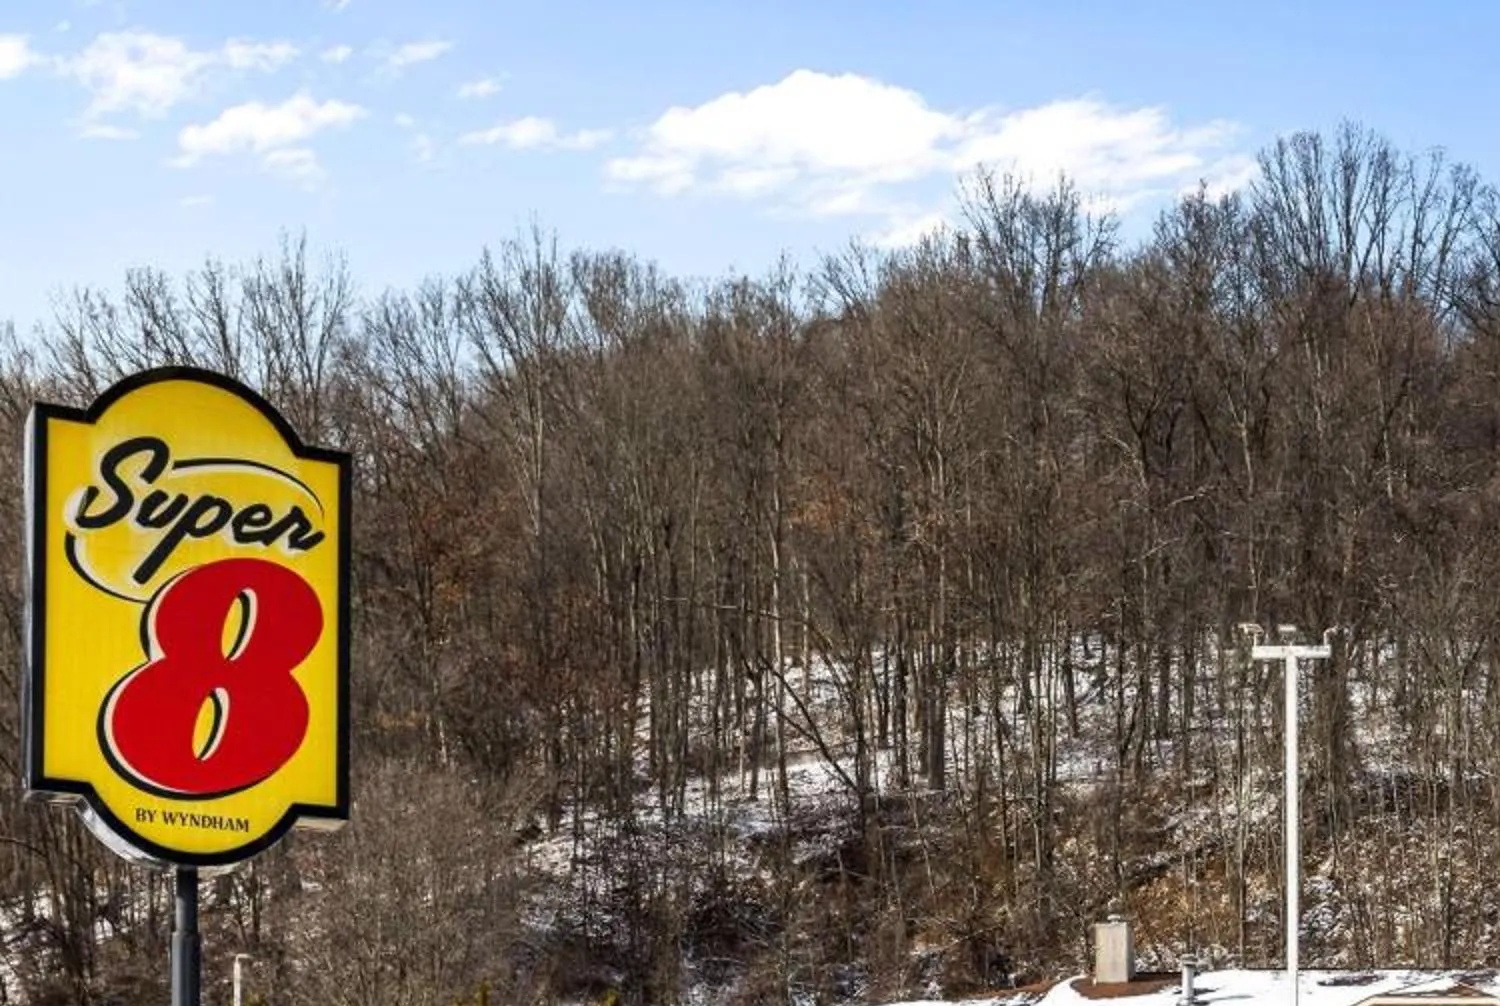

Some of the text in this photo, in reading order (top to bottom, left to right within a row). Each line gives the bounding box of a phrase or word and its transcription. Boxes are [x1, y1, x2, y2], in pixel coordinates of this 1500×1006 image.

[76, 436, 324, 585] Super
[97, 557, 324, 800] 8
[135, 807, 250, 832] BY WYNDHAM
